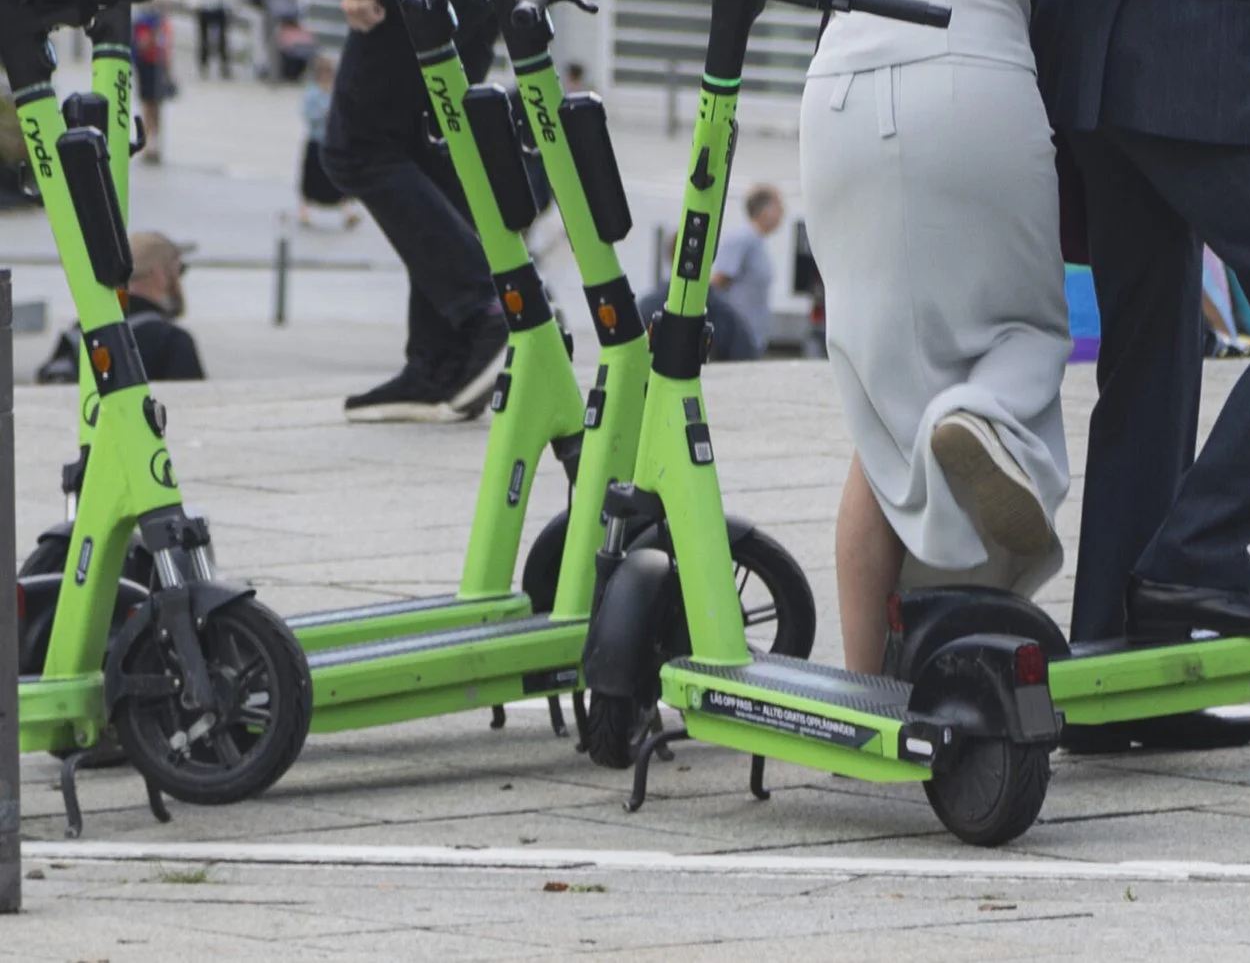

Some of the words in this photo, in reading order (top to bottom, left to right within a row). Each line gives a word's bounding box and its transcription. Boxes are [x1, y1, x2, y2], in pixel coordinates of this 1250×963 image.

[114, 70, 129, 129] ryde
[430, 76, 461, 133] ryde
[527, 85, 557, 144] ryde
[24, 117, 53, 178] ryde
